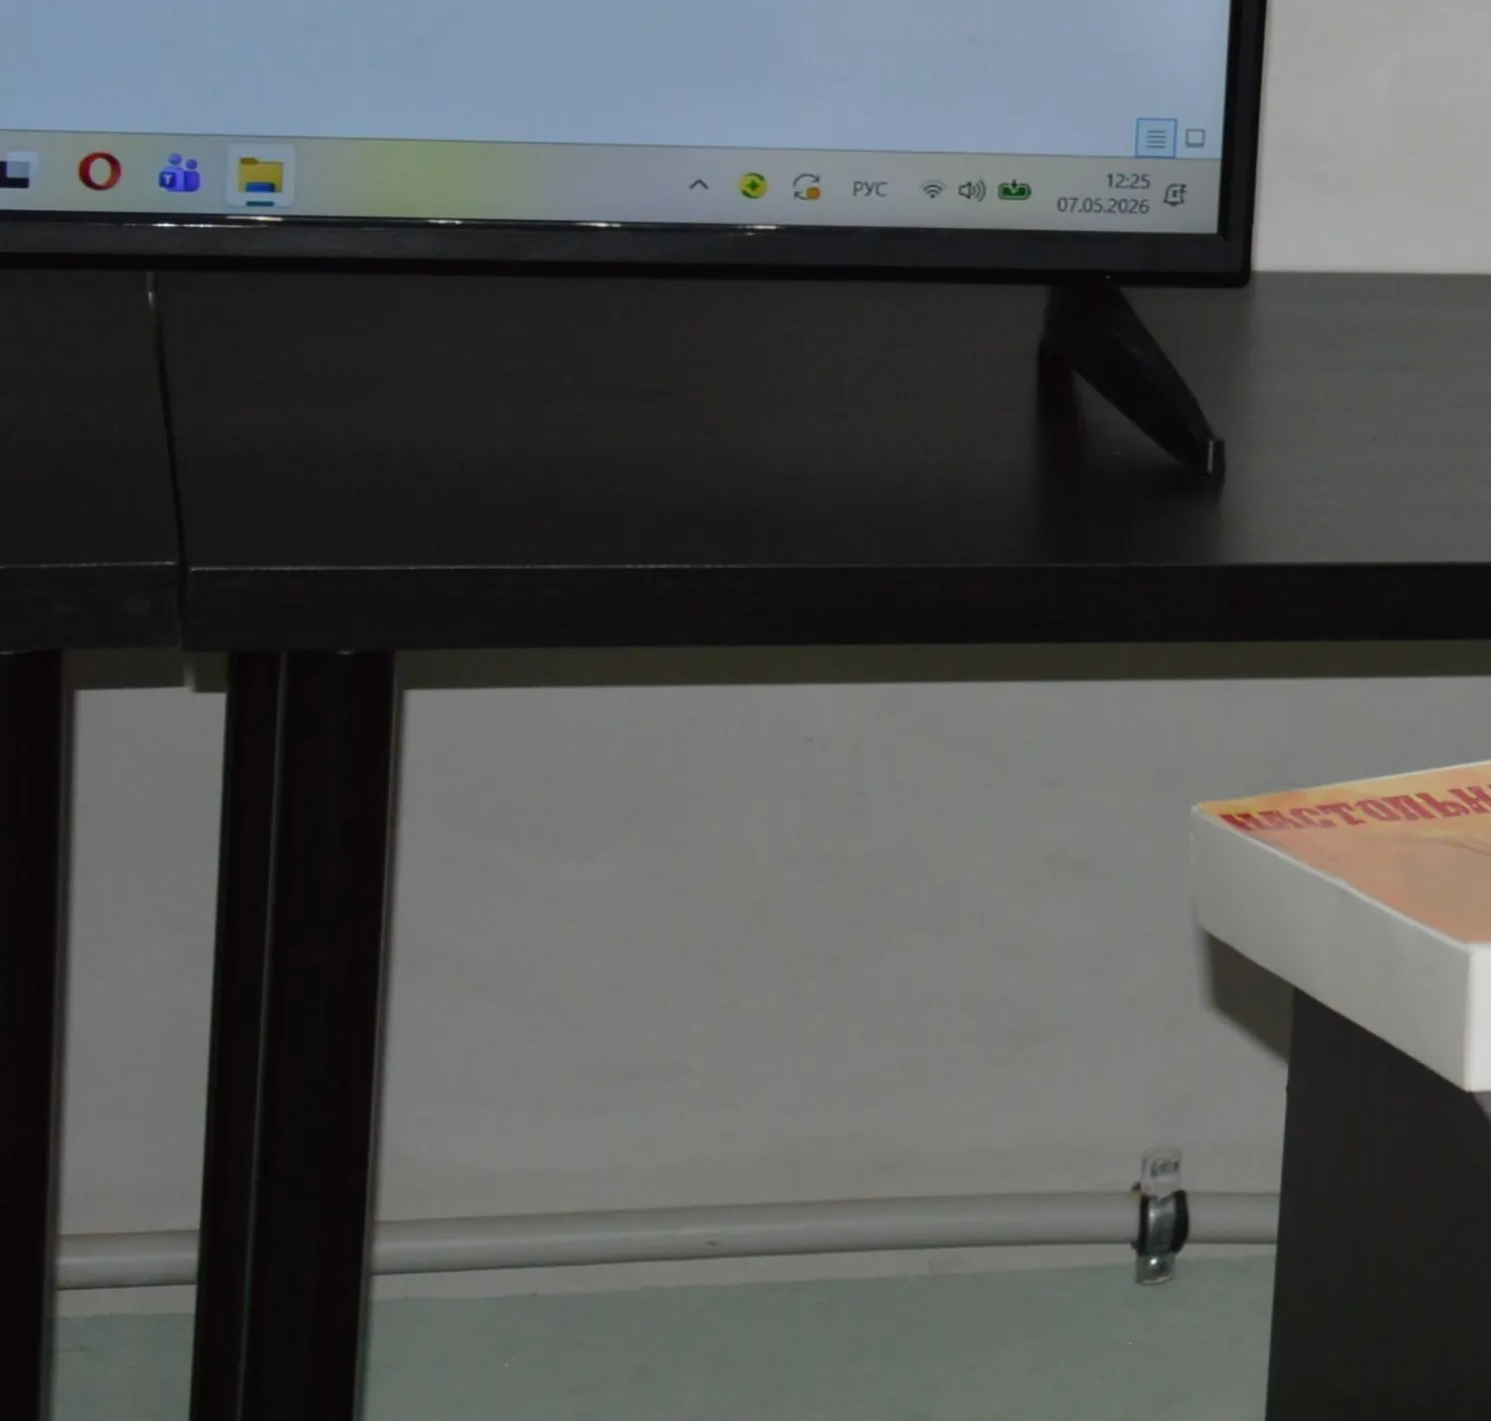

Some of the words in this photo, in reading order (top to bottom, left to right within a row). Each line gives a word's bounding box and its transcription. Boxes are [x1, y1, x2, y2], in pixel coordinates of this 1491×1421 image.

[853, 180, 888, 198] РУС
[1106, 173, 1151, 191] 12:25
[1056, 196, 1151, 214] 07.05.2026
